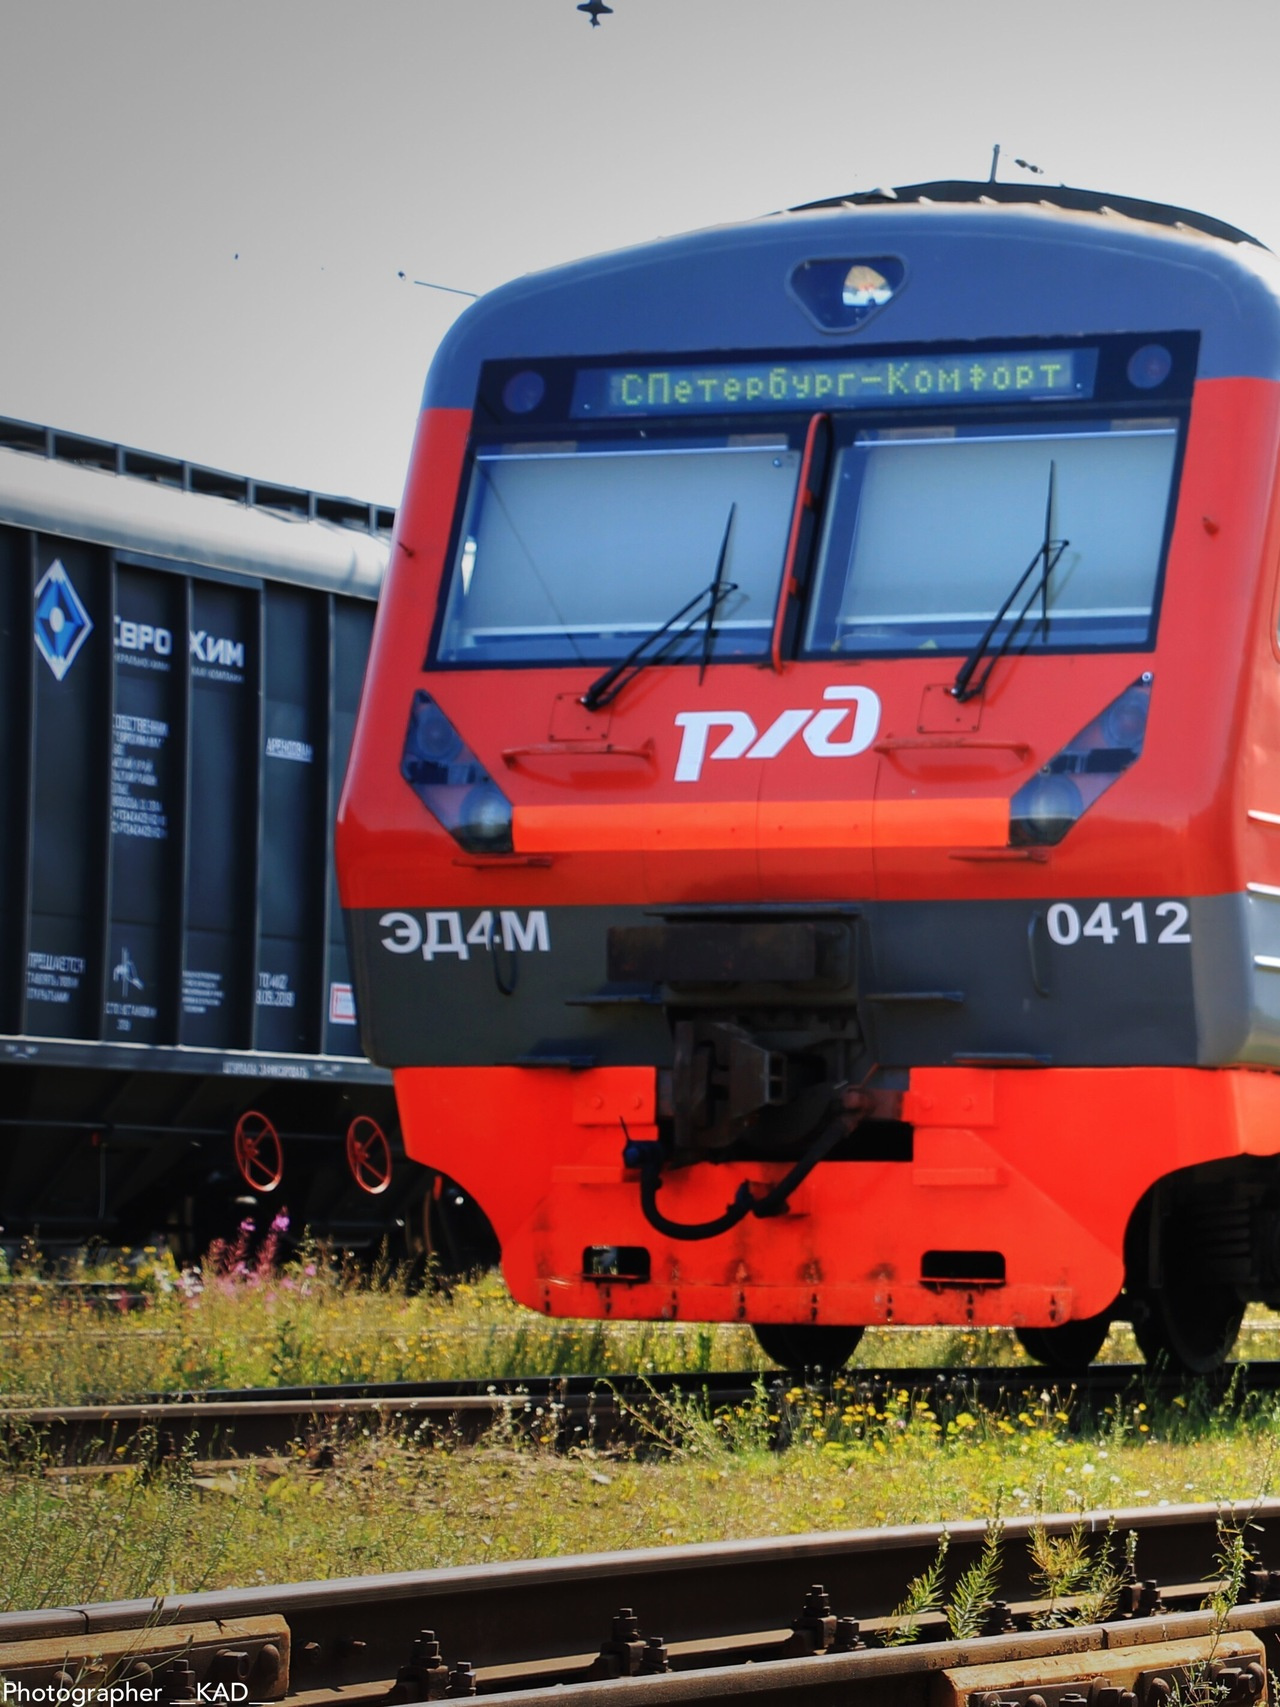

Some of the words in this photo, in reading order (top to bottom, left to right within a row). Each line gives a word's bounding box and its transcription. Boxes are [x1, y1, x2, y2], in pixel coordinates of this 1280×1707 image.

[620, 361, 1061, 407] СПетербург-Комфорт
[379, 911, 551, 961] ЭД4М
[1047, 902, 1192, 945] 0412
